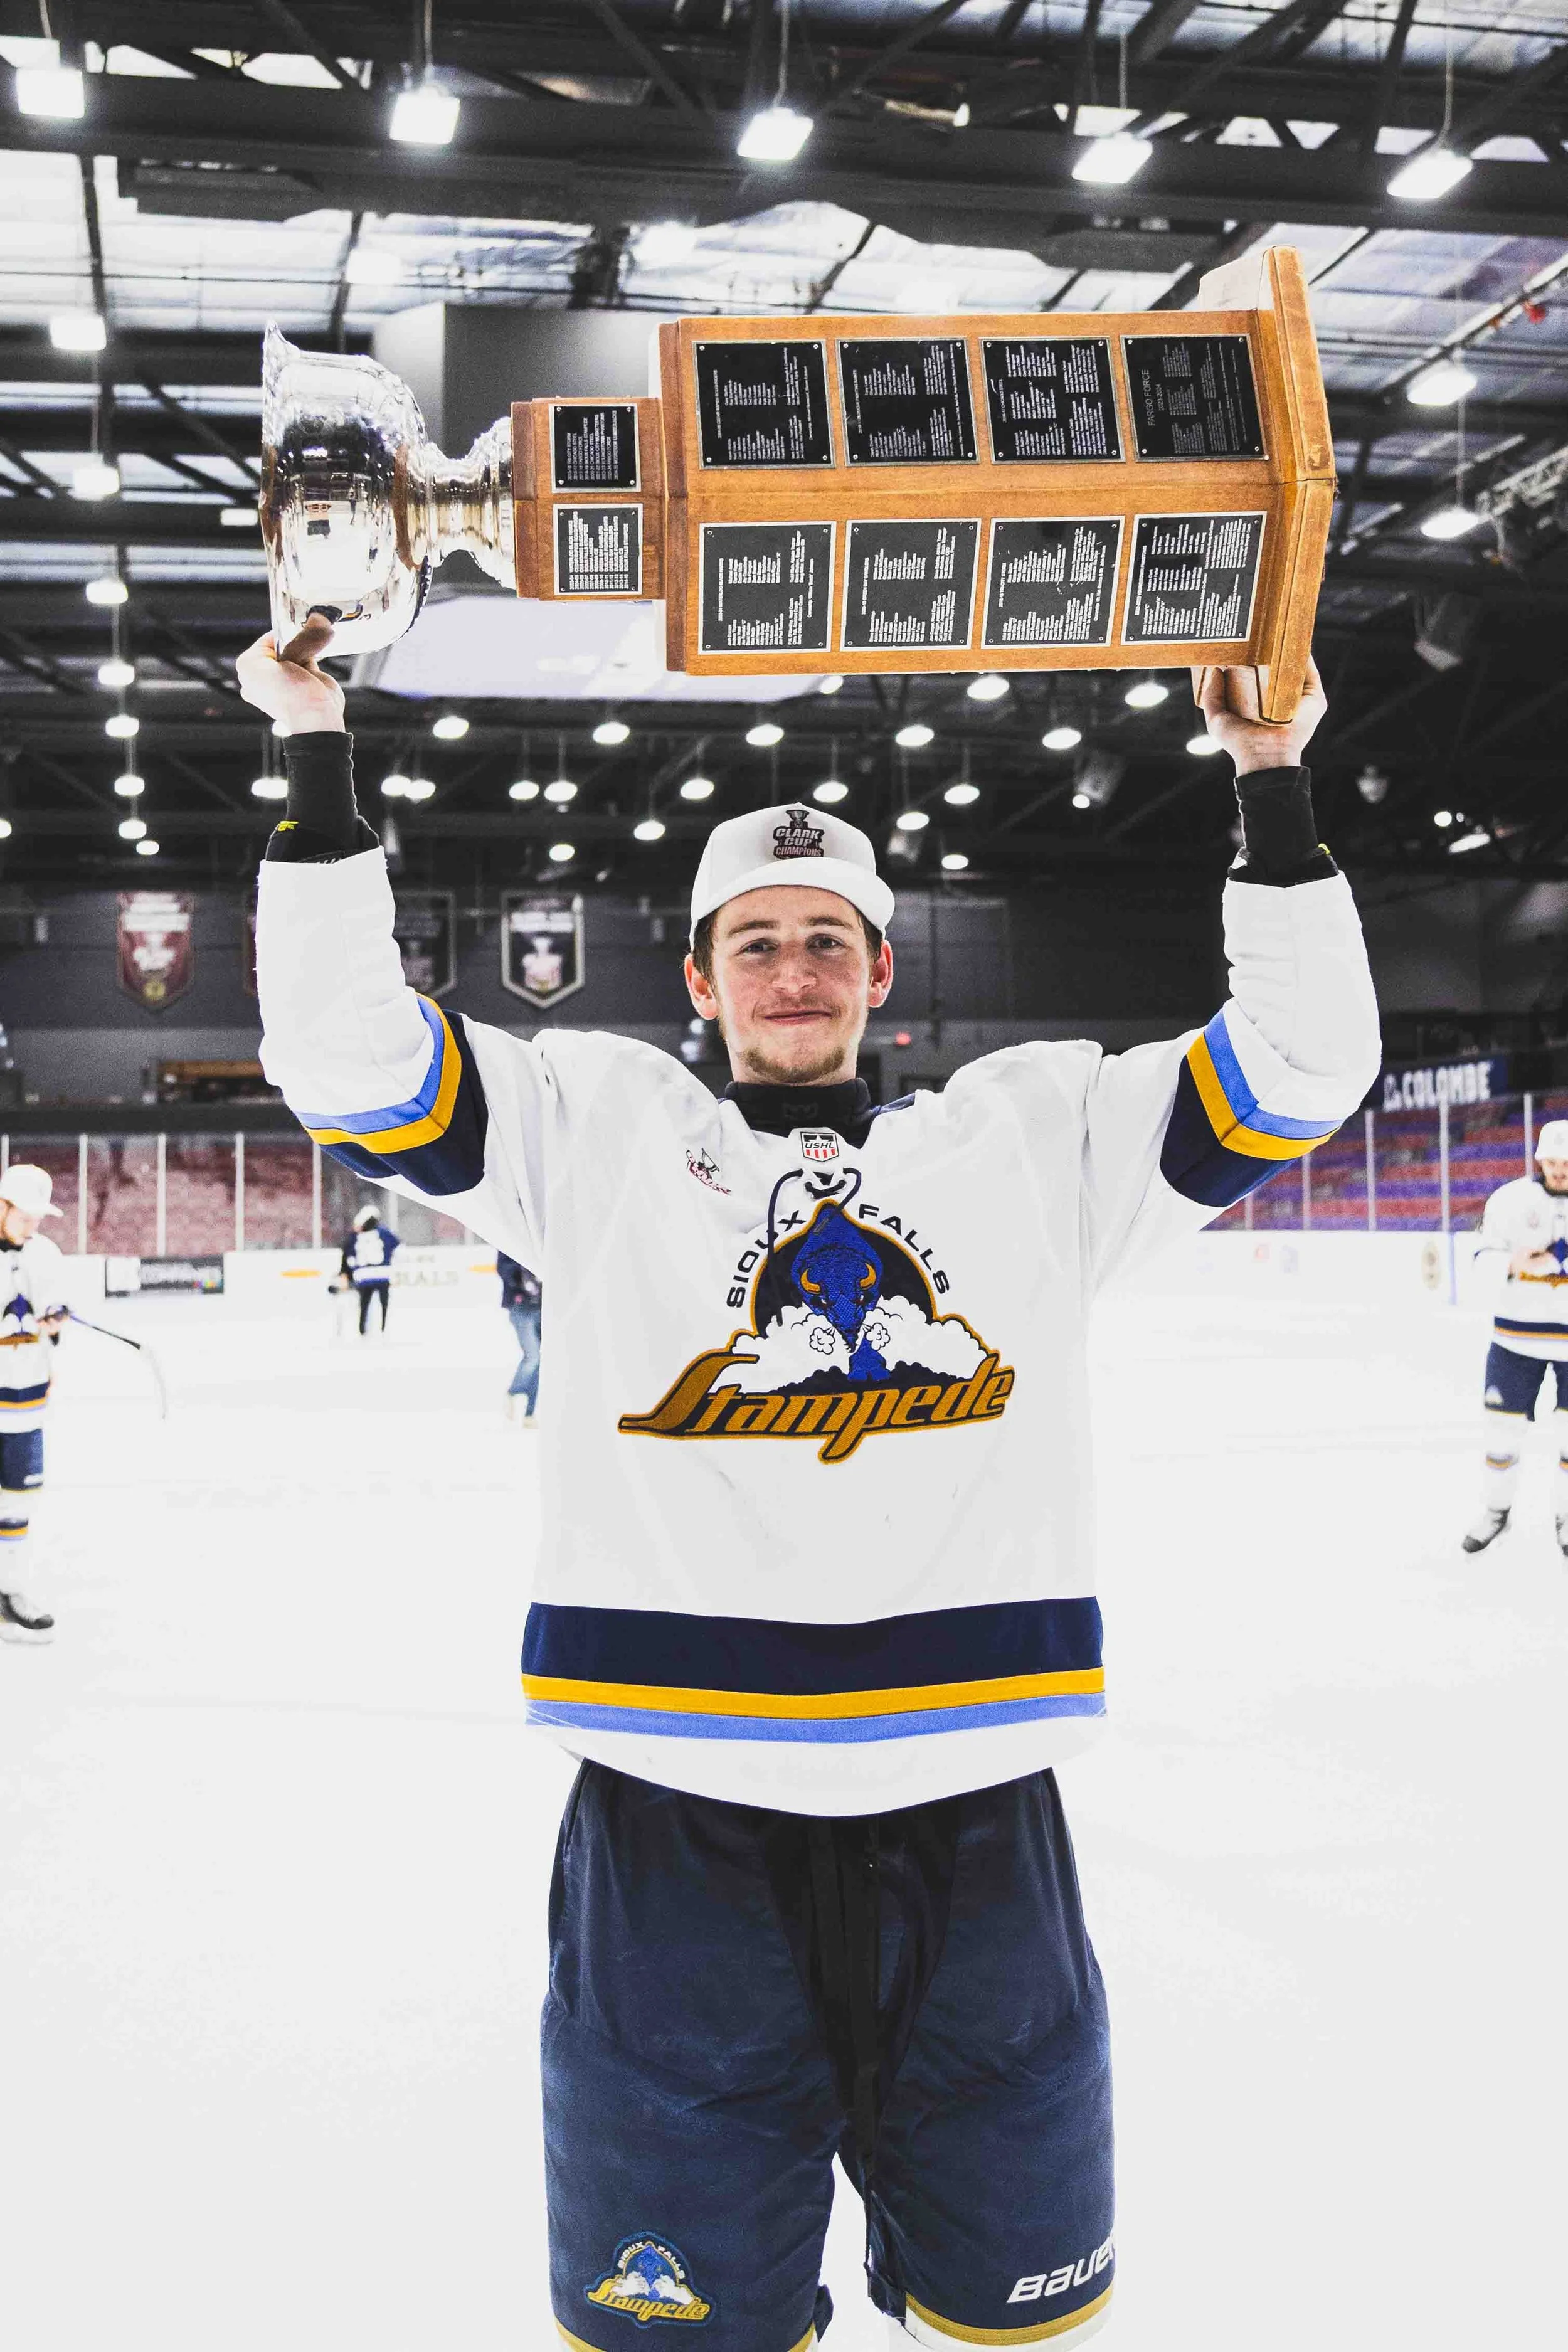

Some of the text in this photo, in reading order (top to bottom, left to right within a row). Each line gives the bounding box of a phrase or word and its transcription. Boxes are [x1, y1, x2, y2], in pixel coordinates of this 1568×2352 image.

[1142, 369, 1156, 426] FARGO FORCE
[776, 828, 820, 839] CLARK
[776, 846, 821, 856] CHAMPIONS
[784, 837, 812, 847] CUP
[726, 1203, 950, 1308] SIOUX FALLS
[618, 1350, 1015, 1463] Stampede
[617, 2241, 645, 2269] SIOUX
[586, 2275, 711, 2321] Stampede
